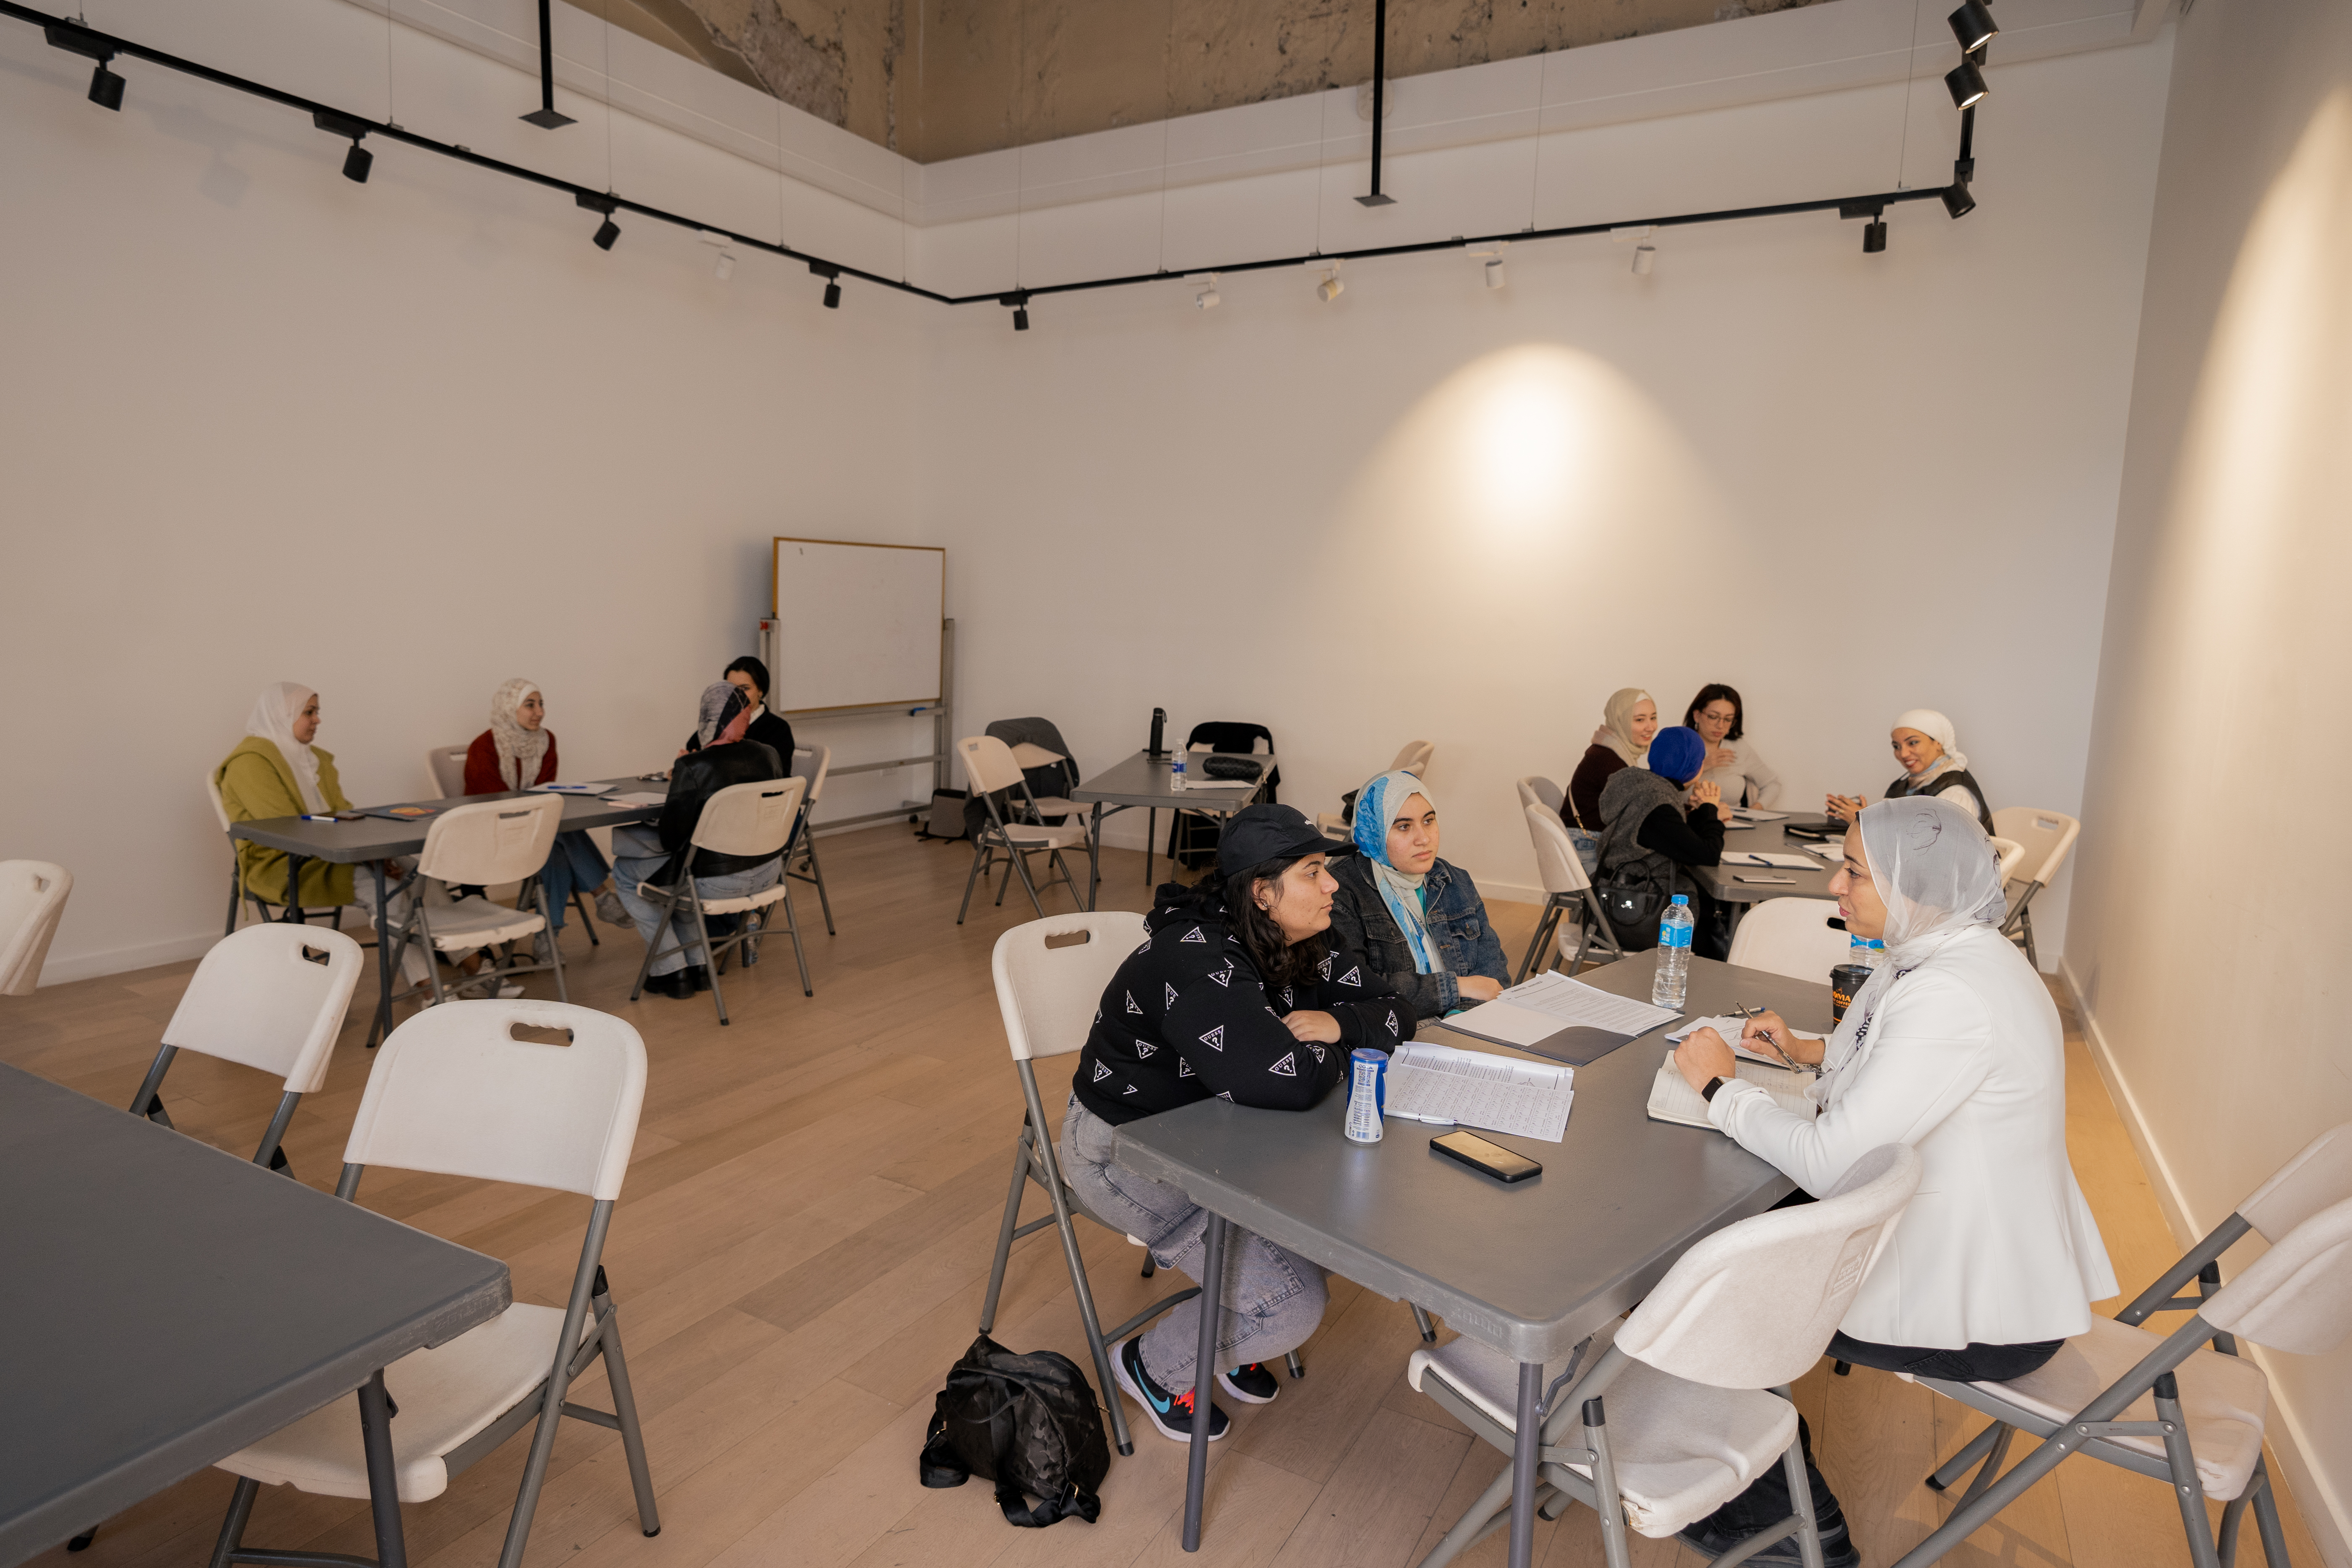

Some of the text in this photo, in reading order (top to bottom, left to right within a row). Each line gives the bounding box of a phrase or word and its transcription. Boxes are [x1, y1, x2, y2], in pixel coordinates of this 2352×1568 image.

[1343, 969, 1357, 982] GUESS
[1204, 1029, 1222, 1041] GUESS
[1274, 1056, 1292, 1071] GUESS
